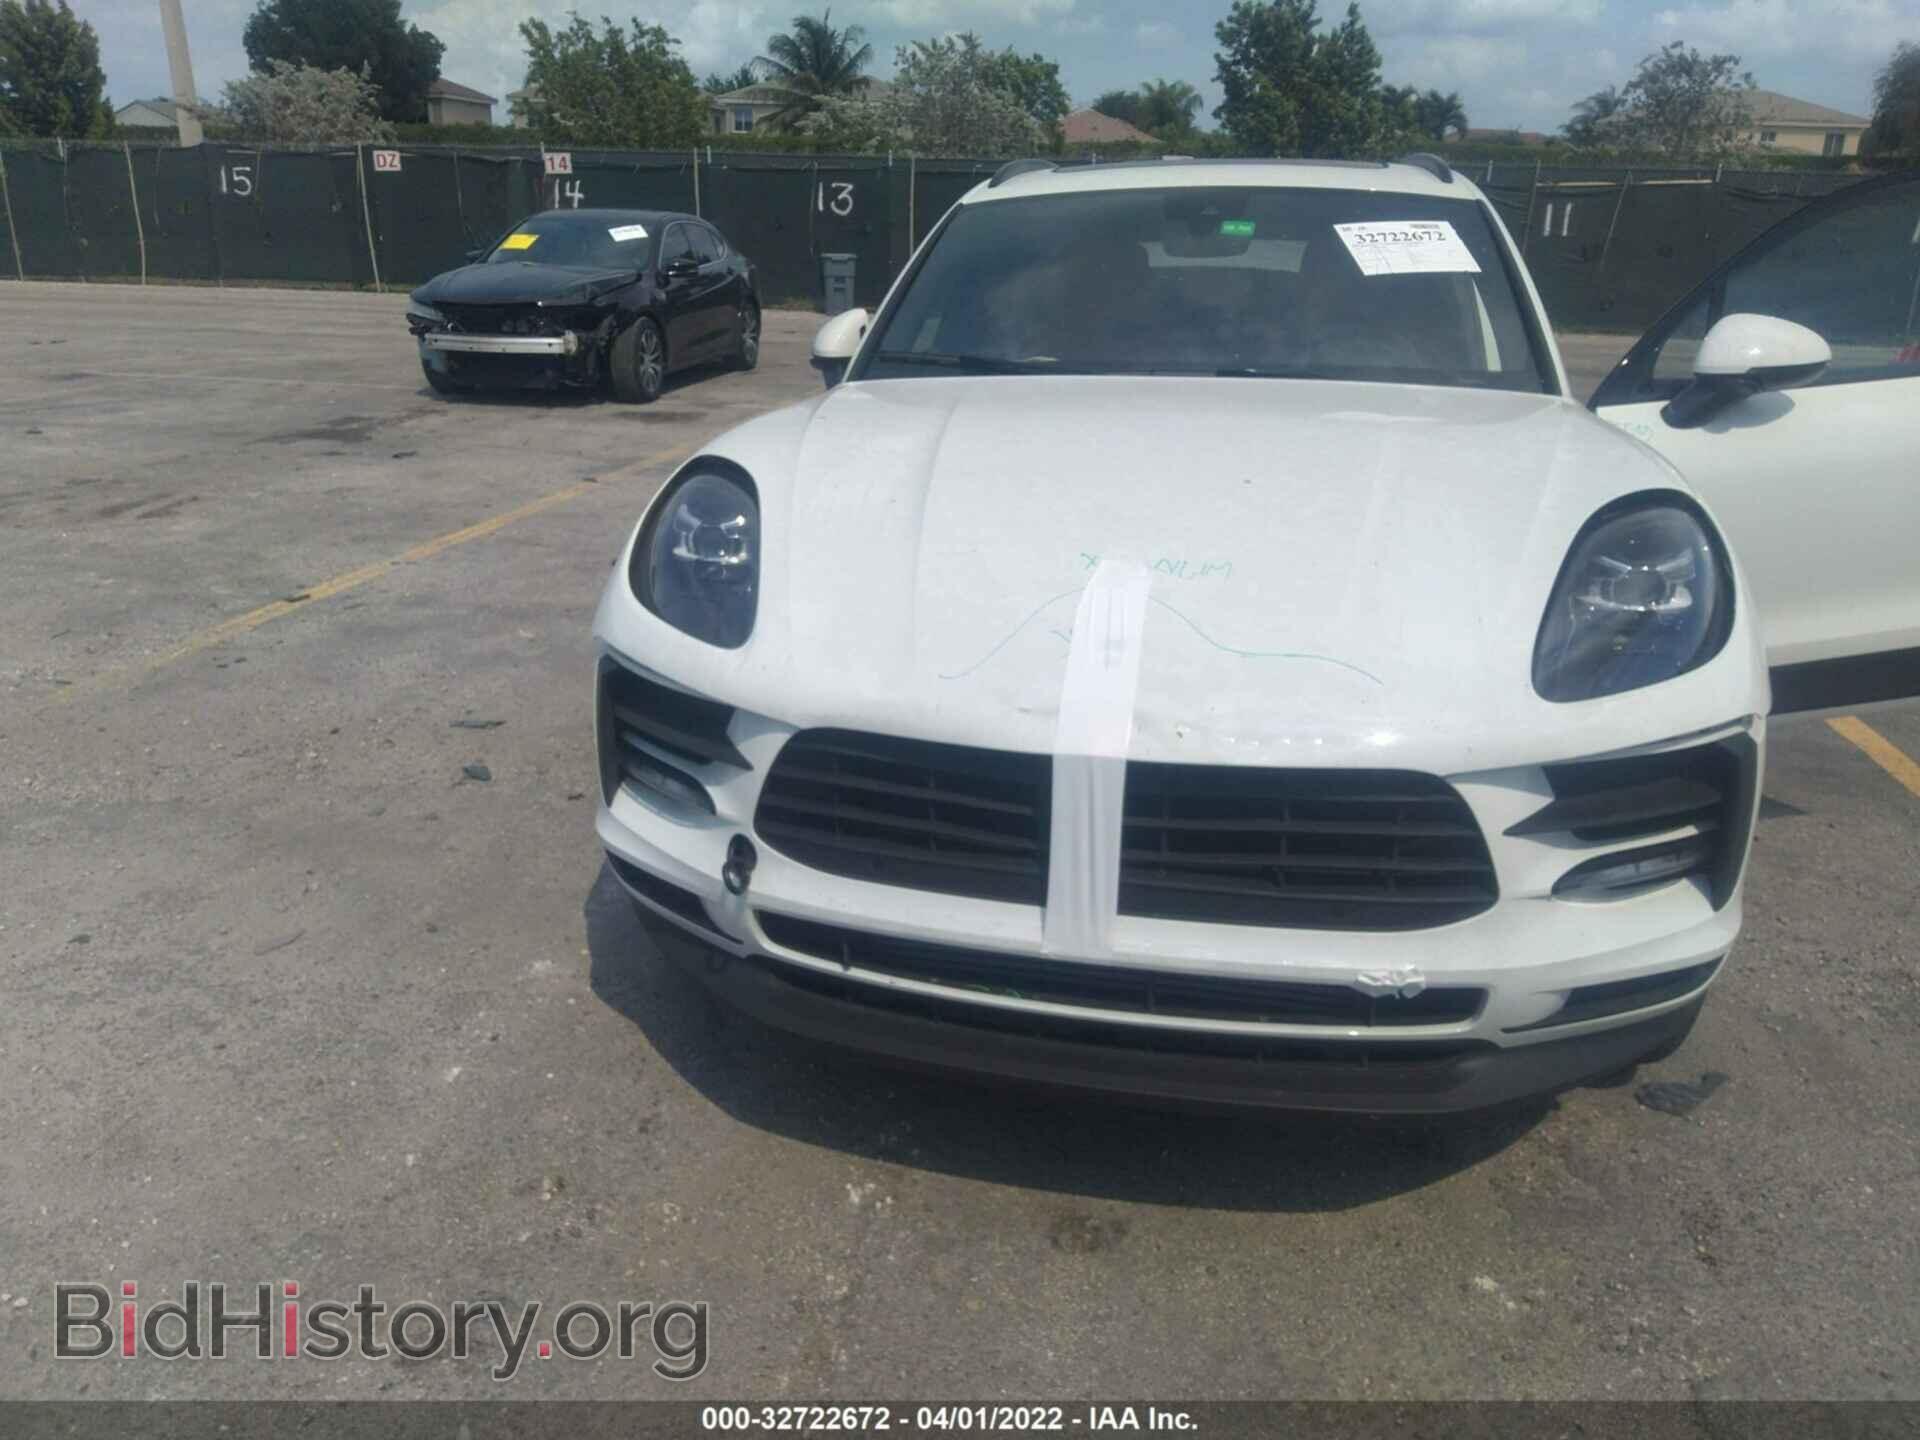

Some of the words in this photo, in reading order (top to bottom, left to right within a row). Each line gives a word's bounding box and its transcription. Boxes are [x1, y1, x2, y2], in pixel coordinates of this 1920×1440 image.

[548, 156, 568, 170] 14
[220, 165, 252, 196] 15
[554, 178, 584, 209] 14
[817, 181, 854, 216] 13
[1543, 203, 1572, 237] 11
[1353, 231, 1447, 244] 32722672
